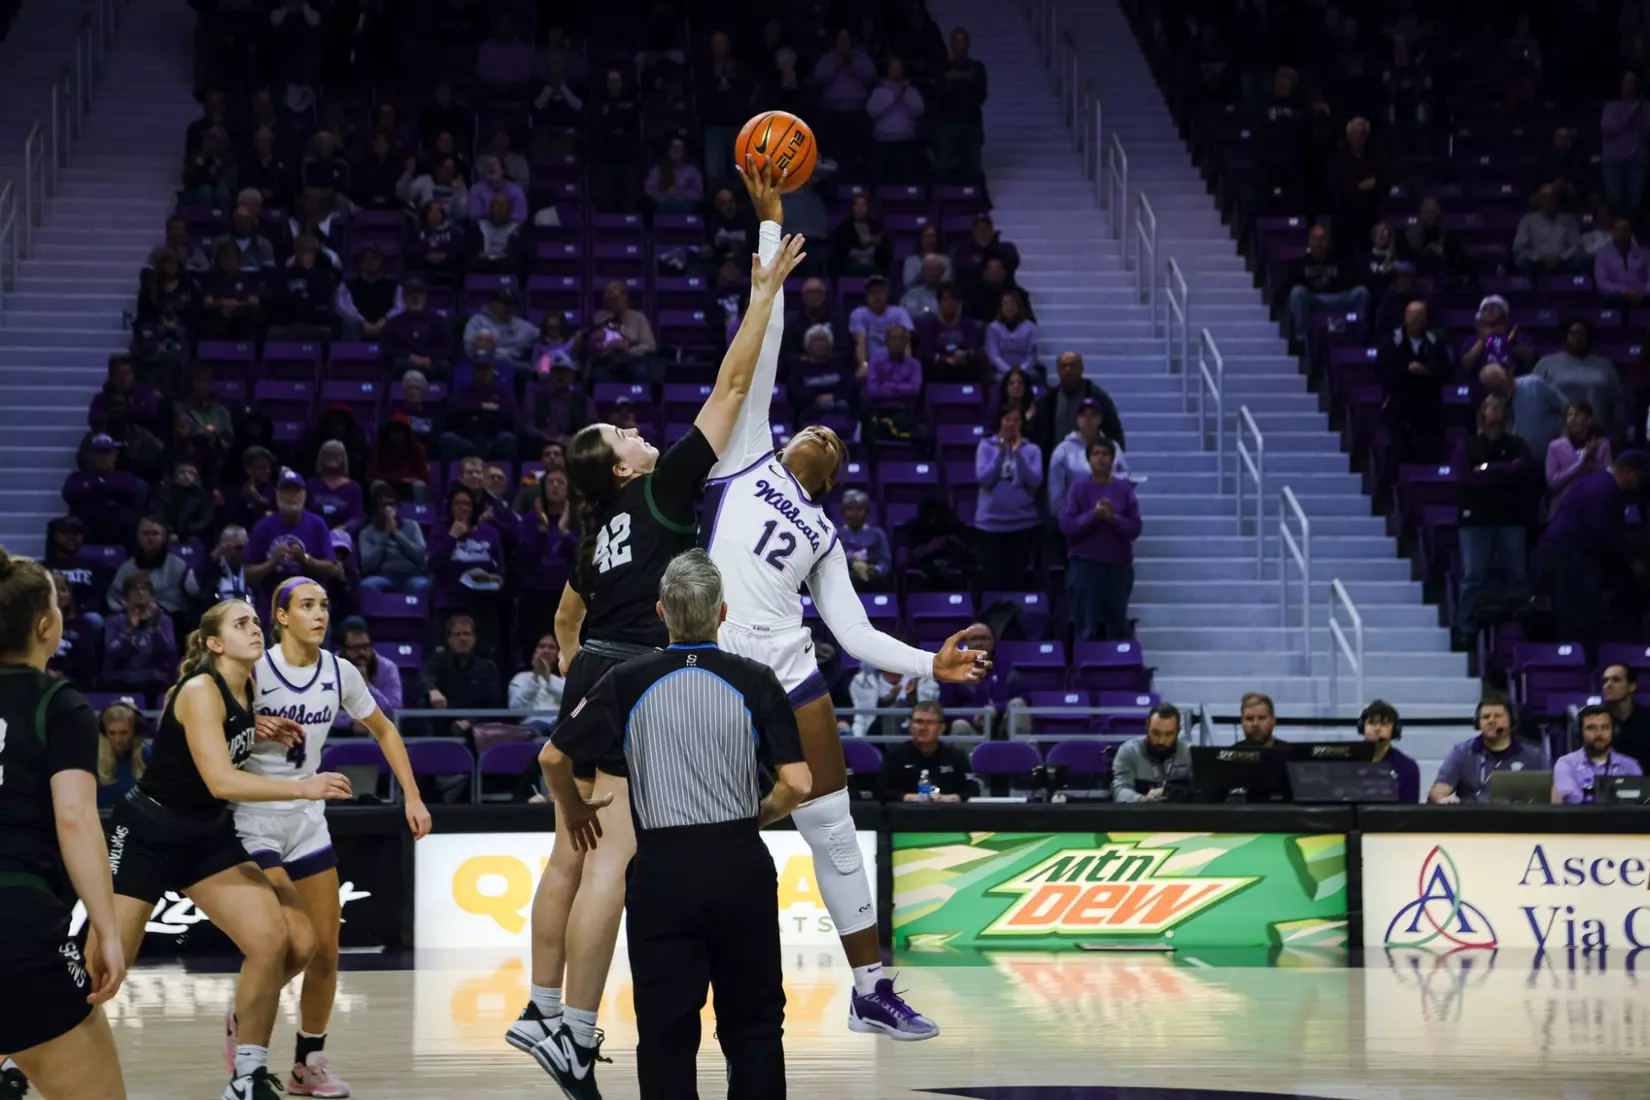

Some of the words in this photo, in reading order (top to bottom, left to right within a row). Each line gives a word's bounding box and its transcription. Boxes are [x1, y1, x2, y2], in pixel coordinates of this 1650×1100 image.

[592, 512, 632, 574] 42
[753, 479, 820, 554] Wildcats
[753, 519, 797, 572] 12
[1517, 844, 1645, 887] Asce
[1518, 905, 1610, 949] Via
